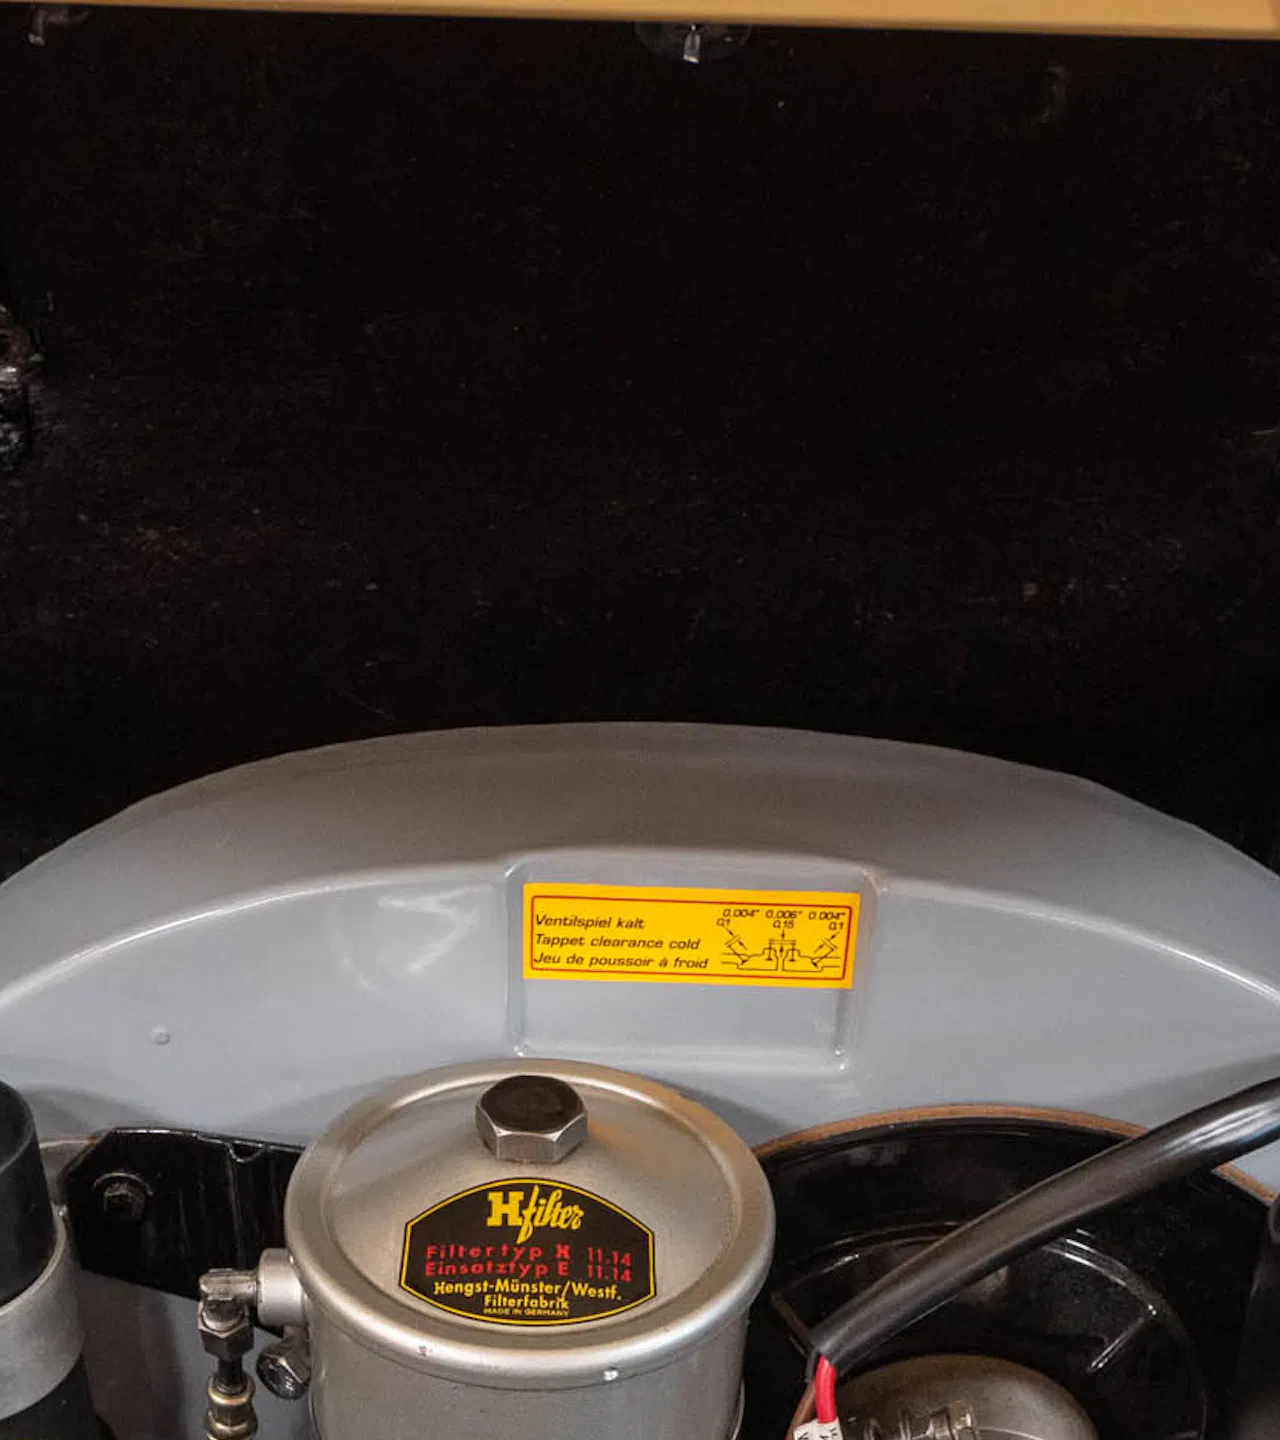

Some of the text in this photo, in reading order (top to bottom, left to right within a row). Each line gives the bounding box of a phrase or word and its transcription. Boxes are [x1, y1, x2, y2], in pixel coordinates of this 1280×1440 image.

[535, 914, 645, 930] Ventilspiel kalt
[535, 933, 701, 950] Tappet clearance cold
[533, 952, 709, 969] Jeu de poussoir à froid
[426, 1242, 544, 1261] Filtertyp
[425, 1260, 549, 1279] Einsatztyp
[557, 1261, 569, 1276] E
[483, 1293, 569, 1310] Filterfabrik
[483, 1307, 511, 1316] MADE
[525, 1308, 569, 1317] GERMANY
